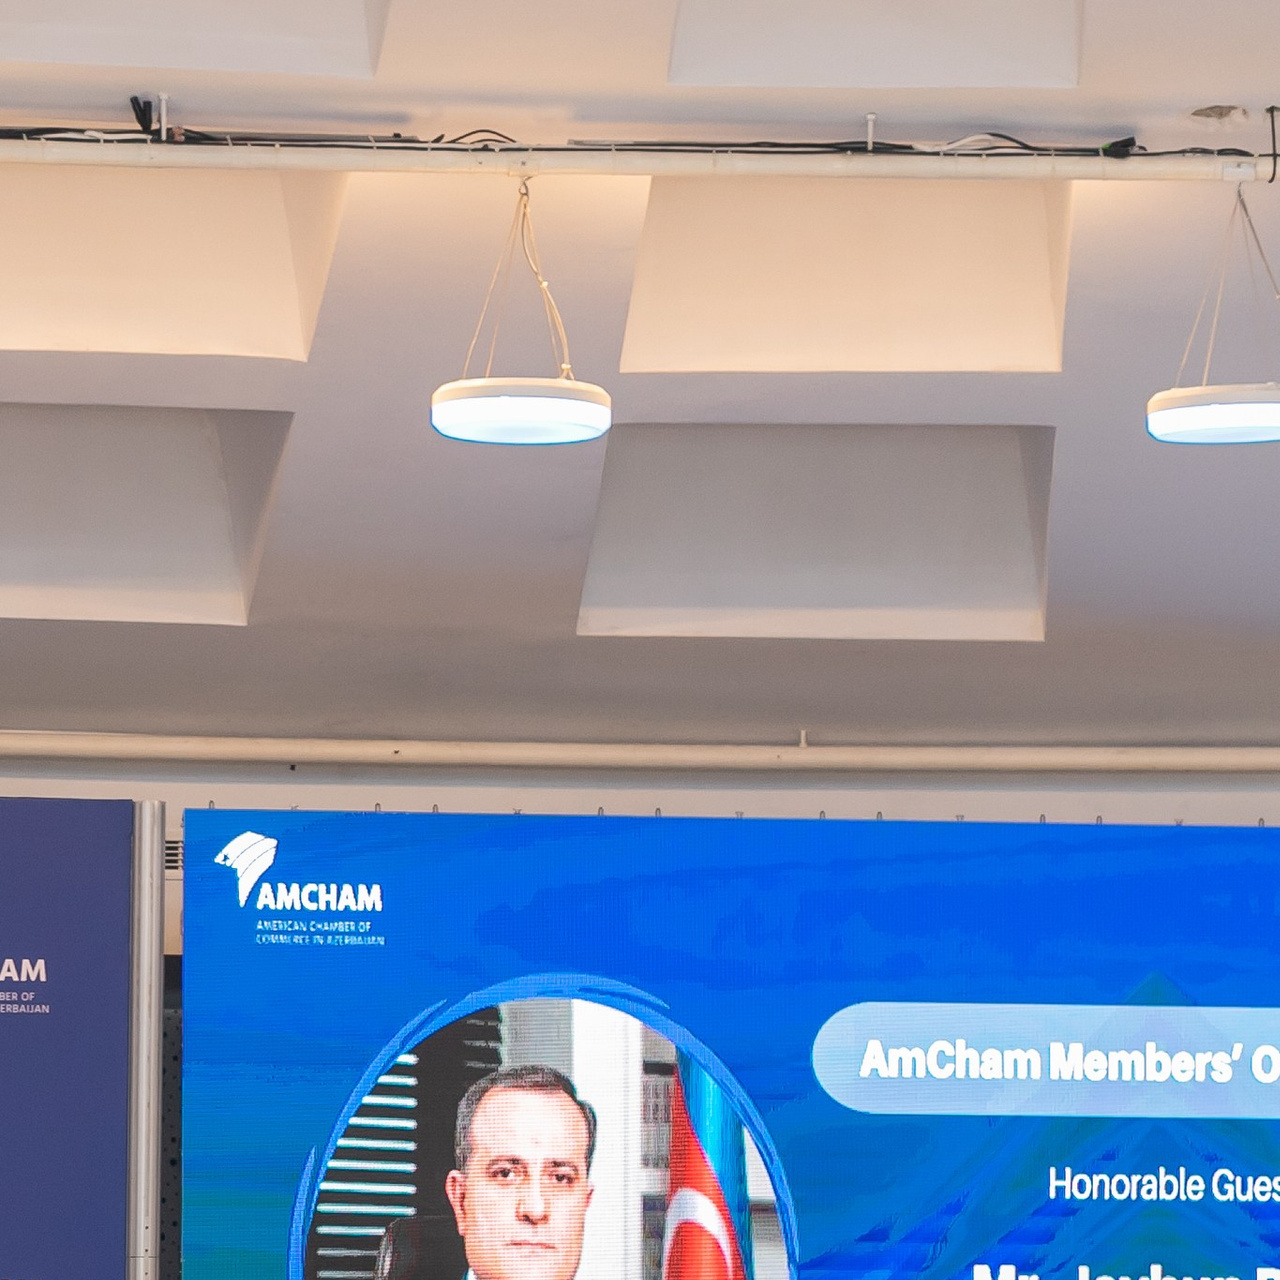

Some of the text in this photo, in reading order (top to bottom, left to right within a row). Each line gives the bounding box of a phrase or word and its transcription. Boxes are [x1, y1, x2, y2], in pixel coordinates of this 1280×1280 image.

[256, 882, 383, 912] AMCHAM
[358, 921, 372, 933] OF
[20, 991, 36, 1002] OF
[859, 1039, 1041, 1080] AmCham
[1049, 1166, 1206, 1201] Honorable
